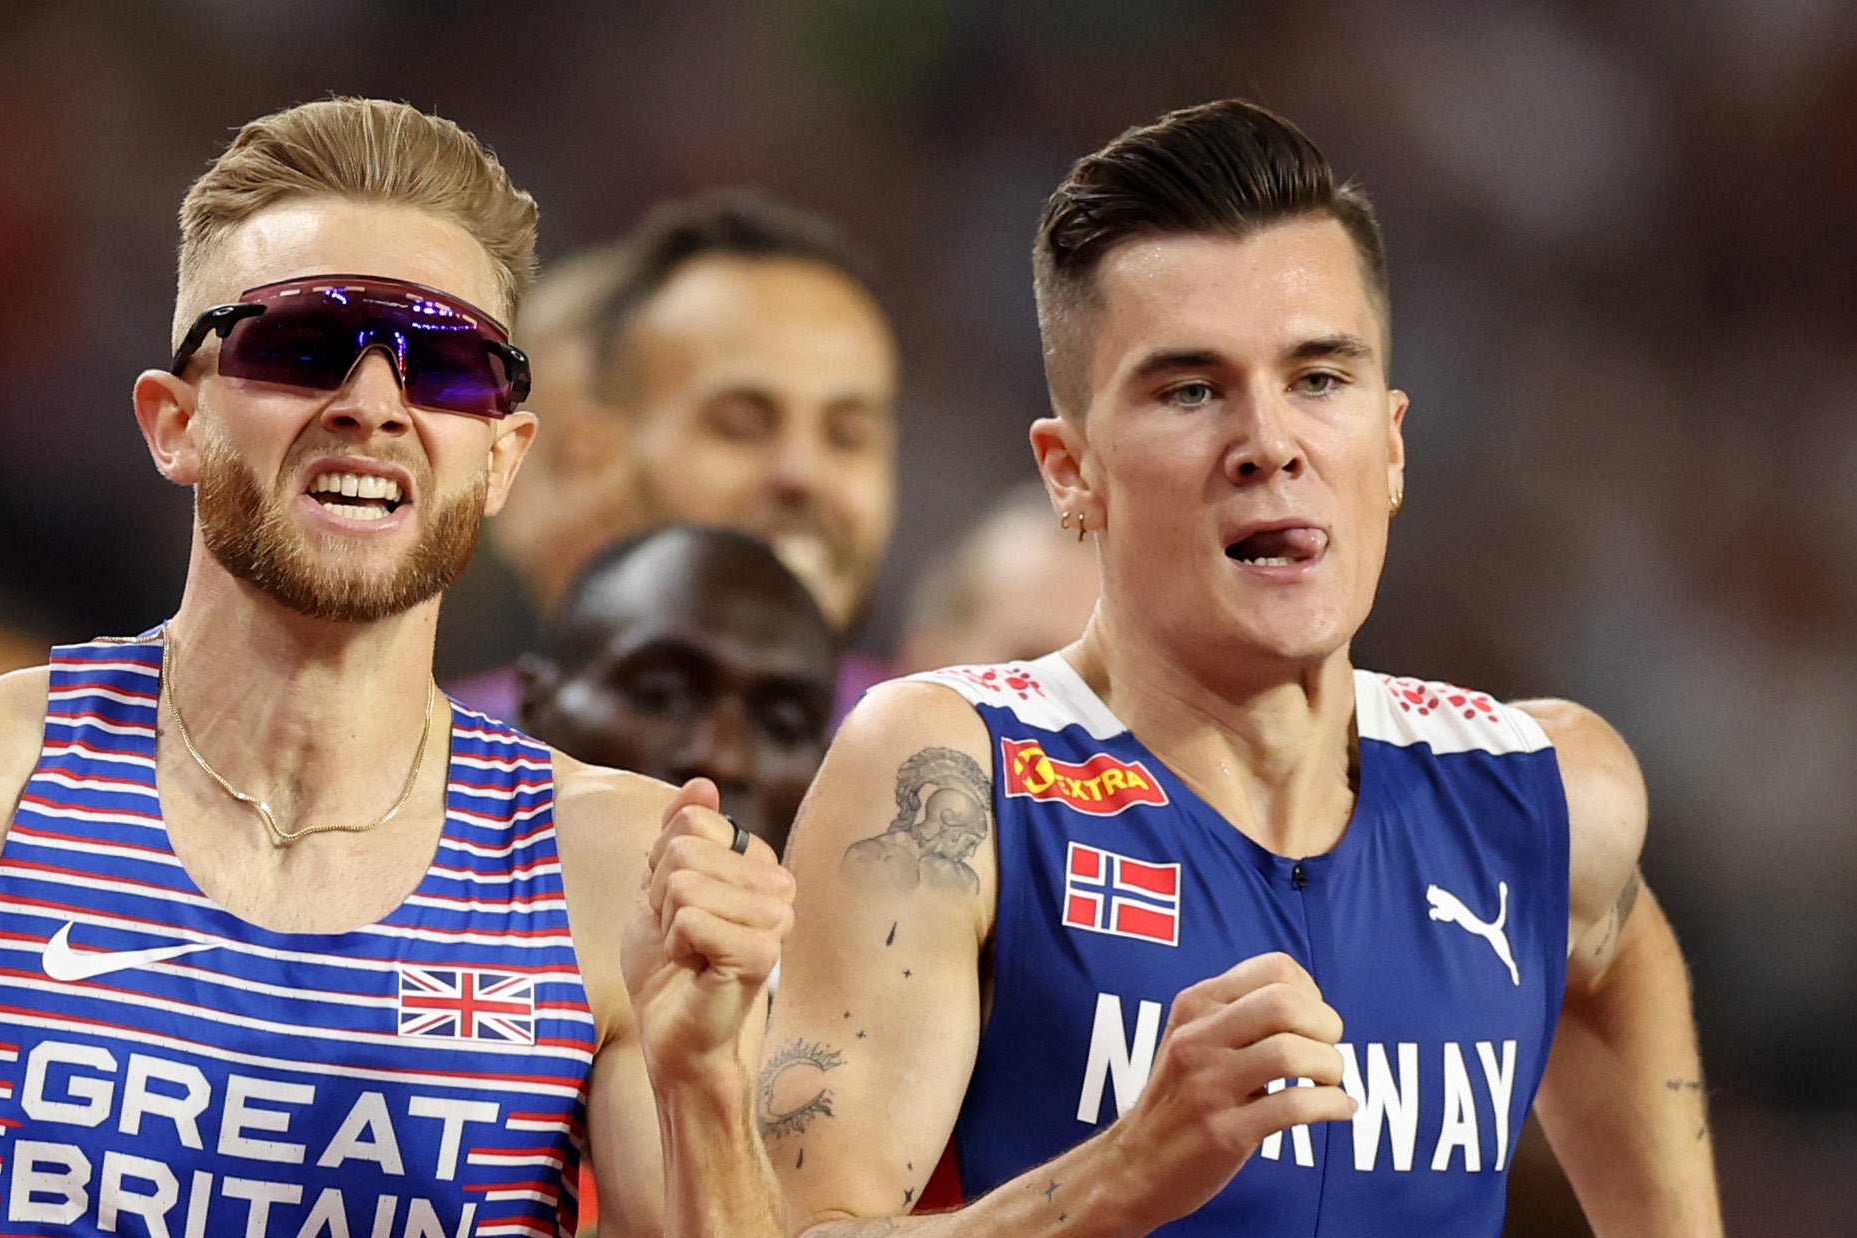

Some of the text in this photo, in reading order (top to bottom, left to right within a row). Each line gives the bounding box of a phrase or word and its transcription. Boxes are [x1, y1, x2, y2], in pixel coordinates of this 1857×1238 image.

[1055, 768, 1150, 802] EXTRA
[20, 1040, 501, 1181] GREAT
[1076, 992, 1517, 1172] NWAY
